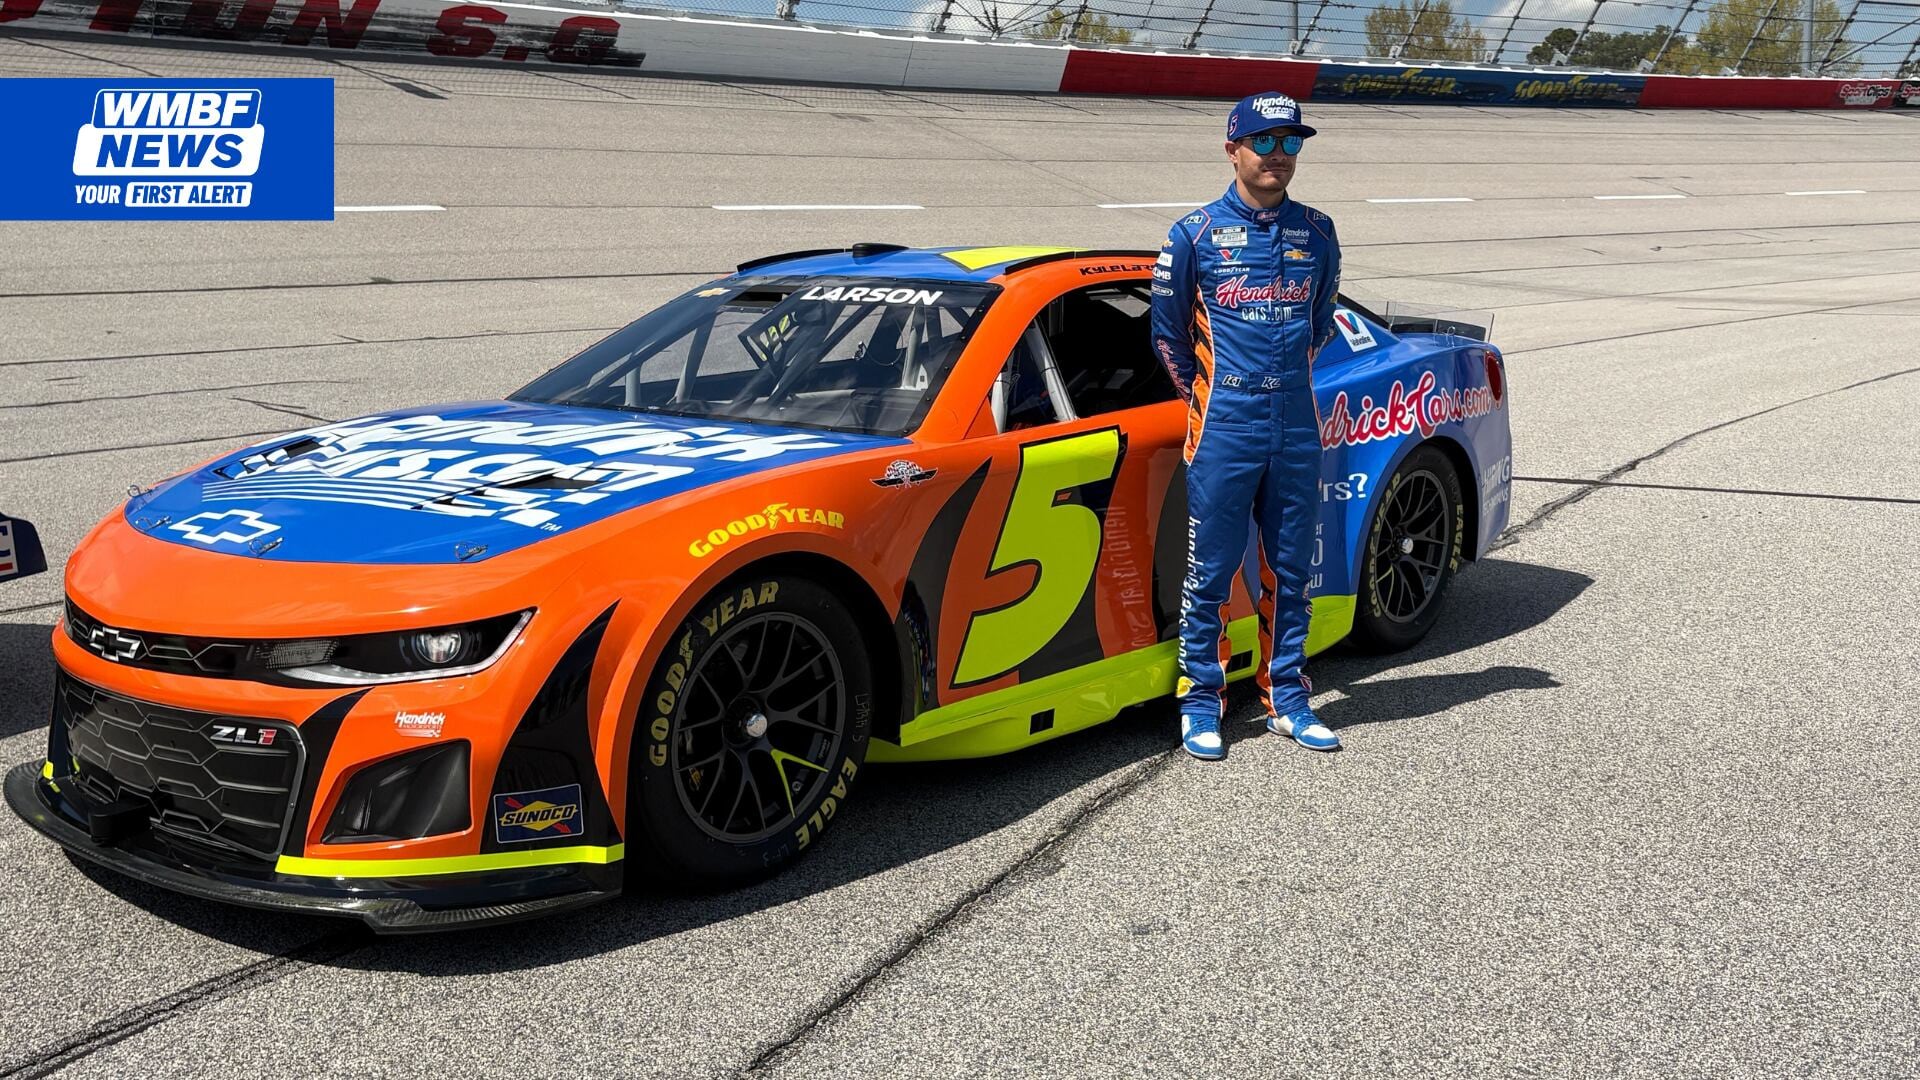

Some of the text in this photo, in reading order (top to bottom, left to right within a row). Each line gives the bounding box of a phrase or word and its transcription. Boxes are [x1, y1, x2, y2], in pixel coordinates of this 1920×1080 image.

[1252, 96, 1296, 111] Hendrick
[800, 286, 943, 306] LARSON
[1216, 274, 1312, 309] Hendrick
[688, 502, 845, 558] GOODYEAR
[1449, 504, 1464, 573] EAGLE
[952, 428, 1121, 686] 5
[649, 580, 780, 767] GOODYEAR
[211, 725, 278, 745] ZL1
[395, 711, 446, 728] Hendrick
[503, 805, 574, 825] SUNOCO
[795, 755, 858, 850] EAGLE
